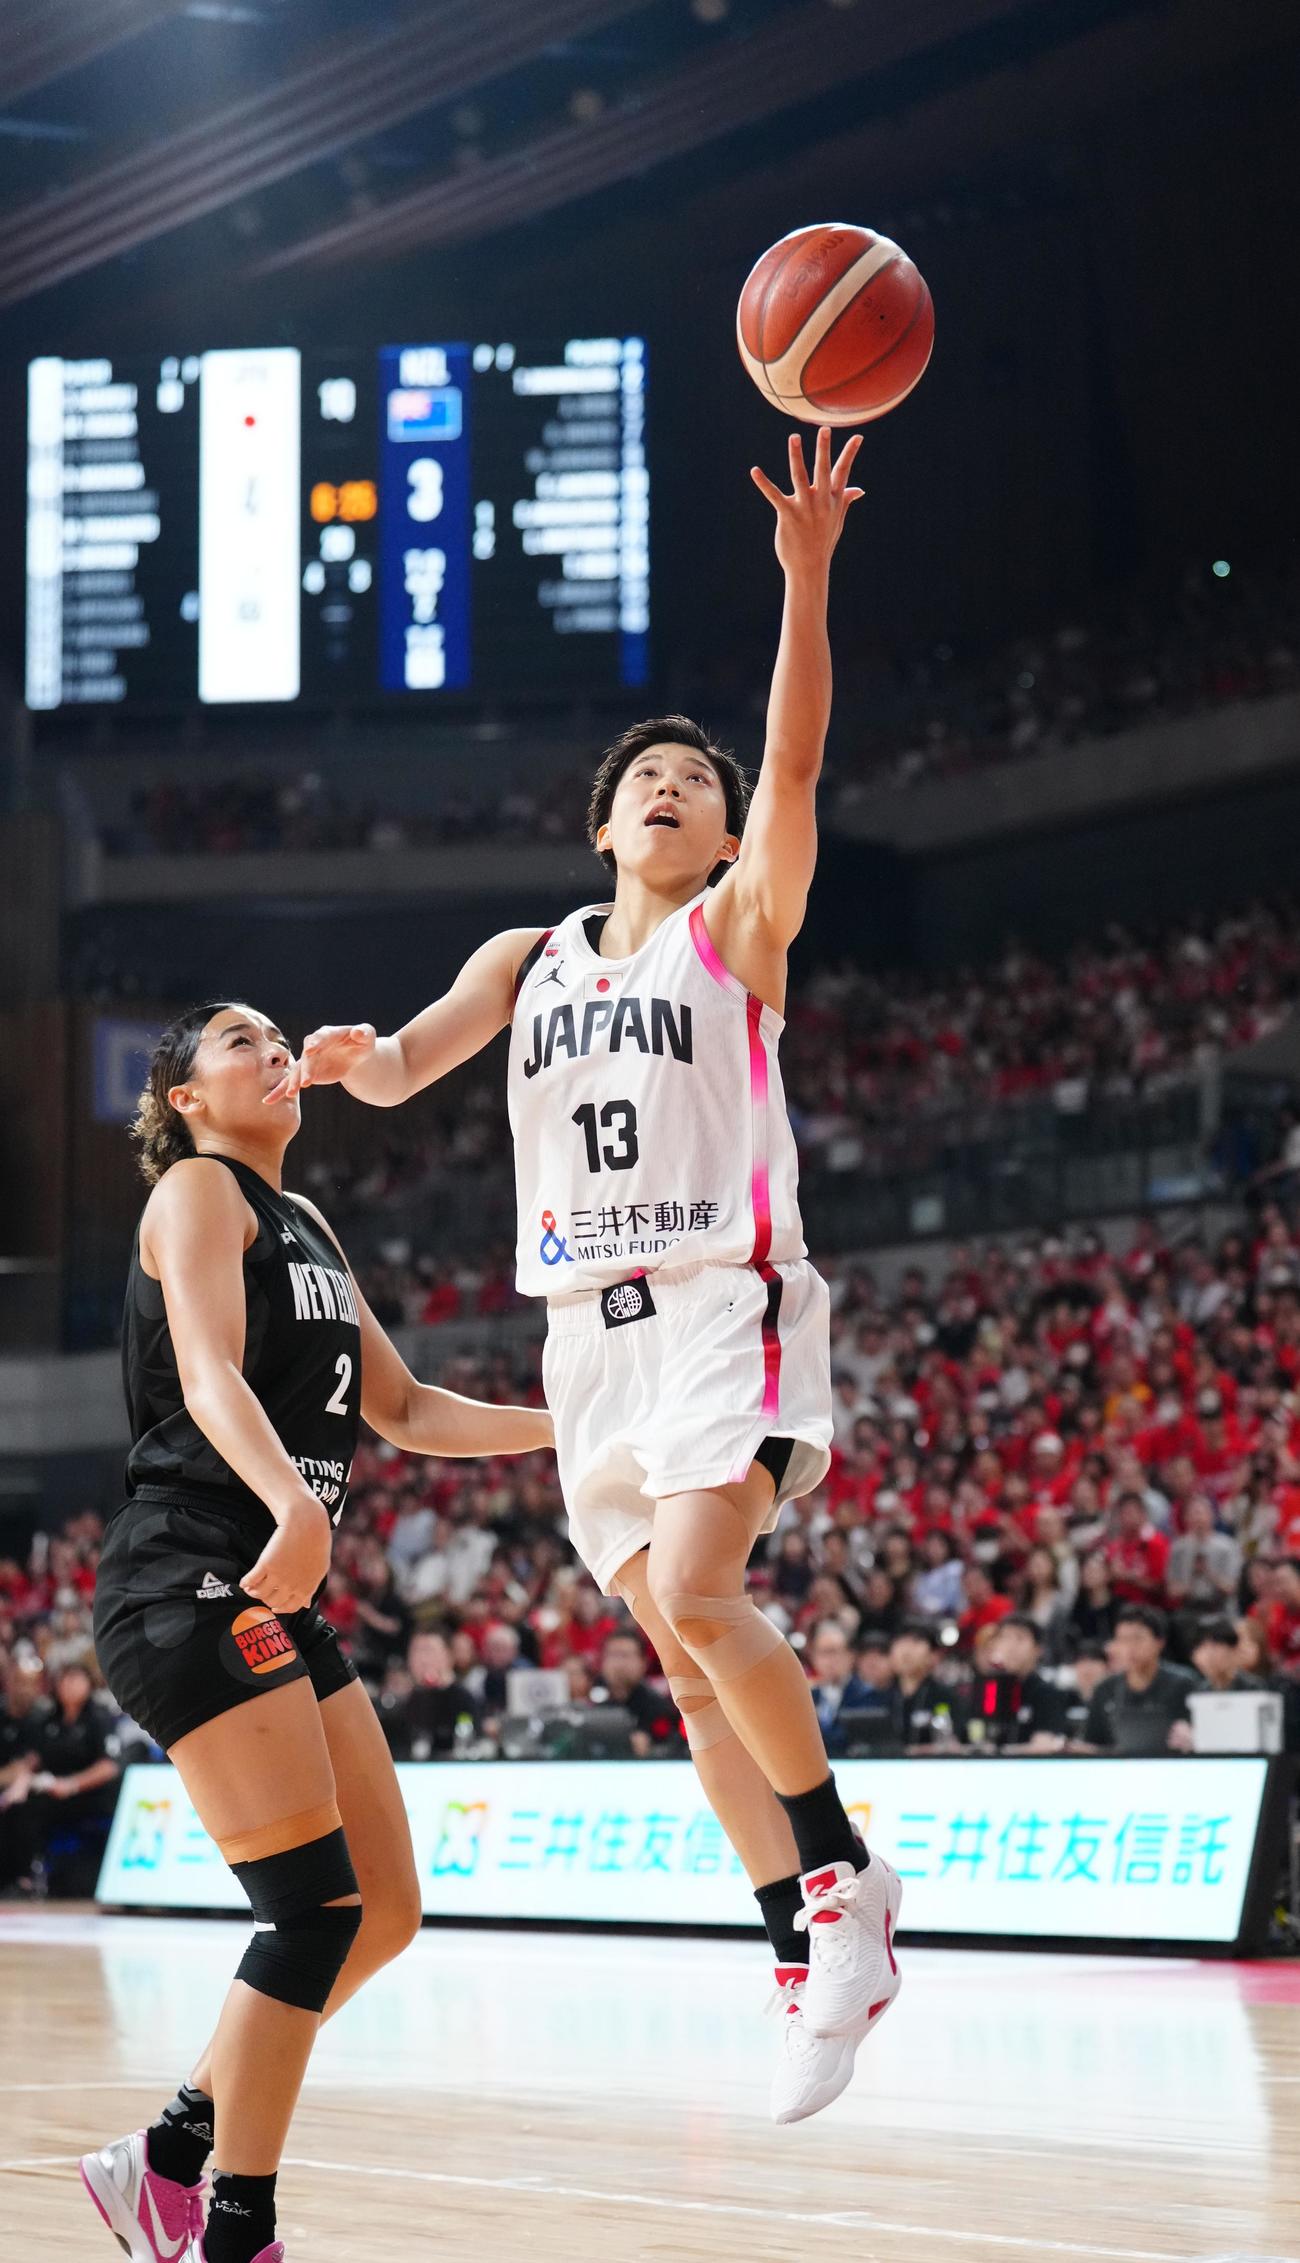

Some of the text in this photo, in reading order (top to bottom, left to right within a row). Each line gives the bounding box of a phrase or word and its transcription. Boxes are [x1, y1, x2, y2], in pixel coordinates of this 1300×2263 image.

[524, 997, 692, 1079] JAPAN
[571, 1099, 639, 1173] 13
[571, 1200, 719, 1238] 三井不動産
[577, 1243, 626, 1260] MITSU
[288, 1262, 337, 1320] NEW
[325, 1353, 352, 1416] 2
[290, 1455, 344, 1482] HTING
[196, 1583, 234, 1599] PEAK
[235, 1619, 285, 1649] BURGER
[242, 1631, 293, 1667] KING
[893, 1811, 1232, 1887] 三井住友信託
[182, 2122, 214, 2144] PEAK
[215, 2200, 253, 2218] PEAK
